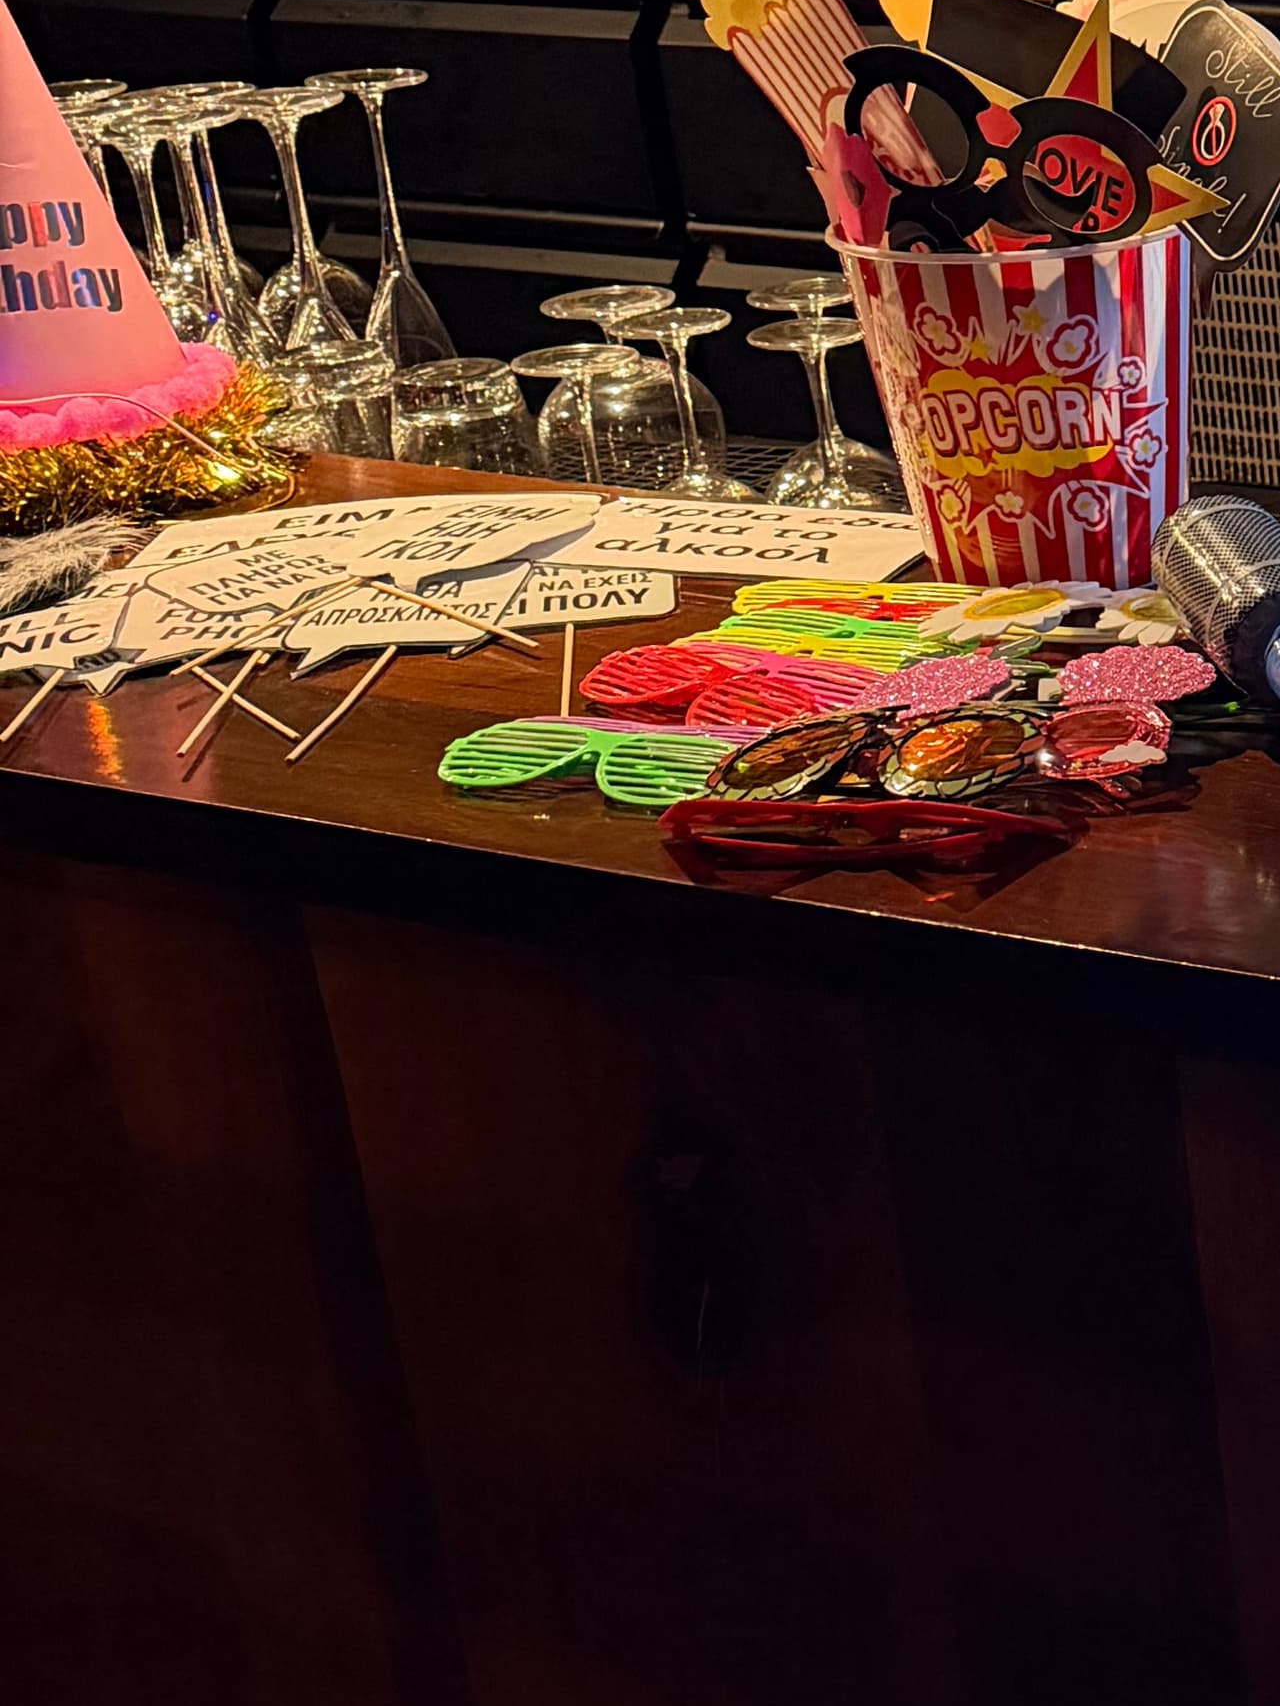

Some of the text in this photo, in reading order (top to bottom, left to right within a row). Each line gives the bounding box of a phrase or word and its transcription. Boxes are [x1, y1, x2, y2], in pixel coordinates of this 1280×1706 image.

[1038, 147, 1126, 218] OVIE
[0, 260, 123, 314] hday
[413, 520, 516, 539] ΗΔΗ
[654, 521, 839, 541] για το
[360, 539, 476, 562] ΓΚΟΛ
[595, 537, 830, 563] αλκοόλ
[262, 570, 316, 591] ΝΑ
[543, 587, 650, 614] ΠΟΛΥ
